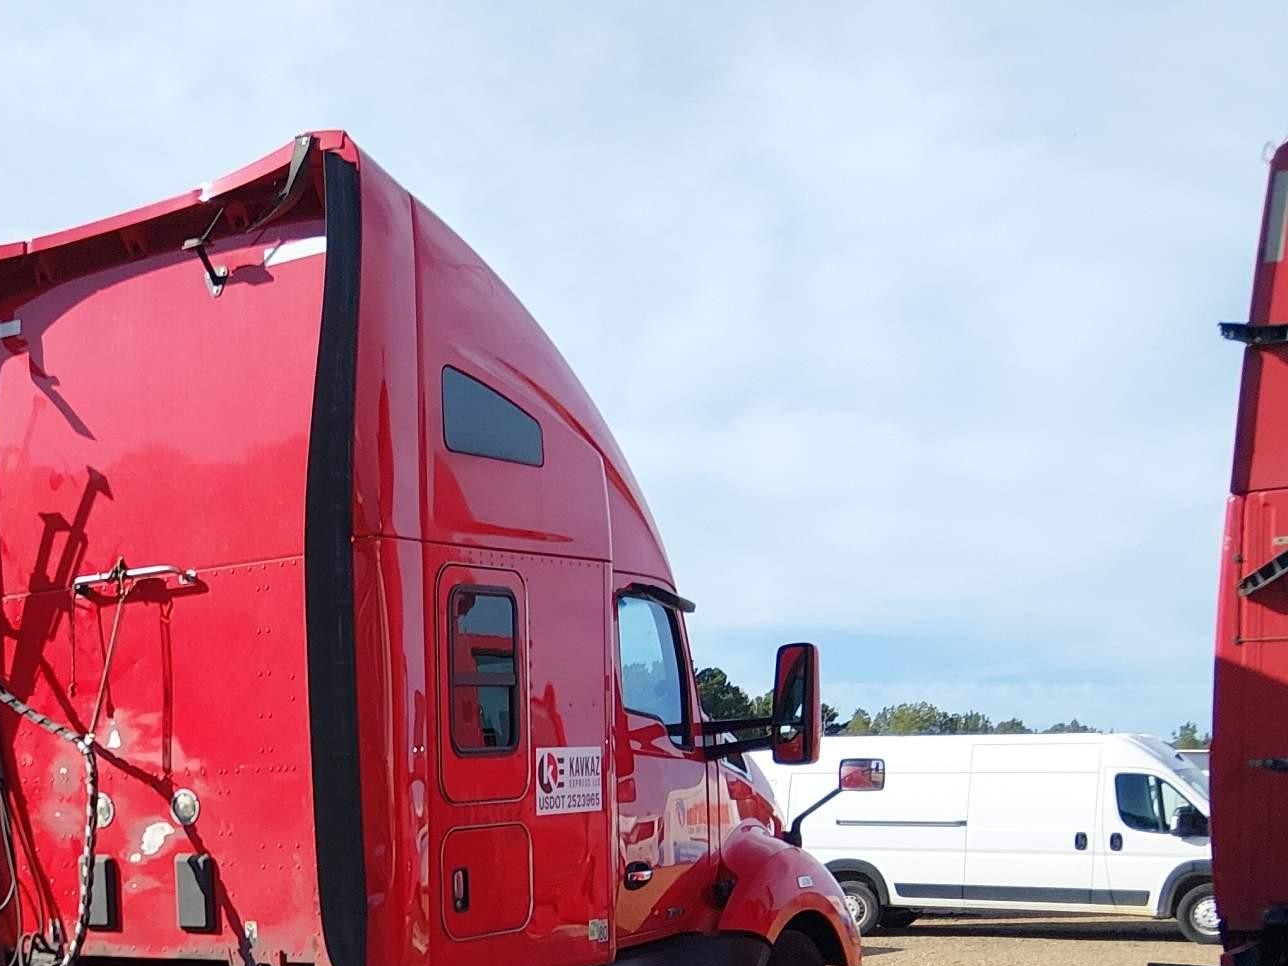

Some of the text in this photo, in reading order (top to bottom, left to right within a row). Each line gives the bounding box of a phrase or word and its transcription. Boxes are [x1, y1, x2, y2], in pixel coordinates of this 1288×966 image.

[569, 755, 600, 777] KAVKAZ
[539, 792, 600, 810] USDOT 2523965
